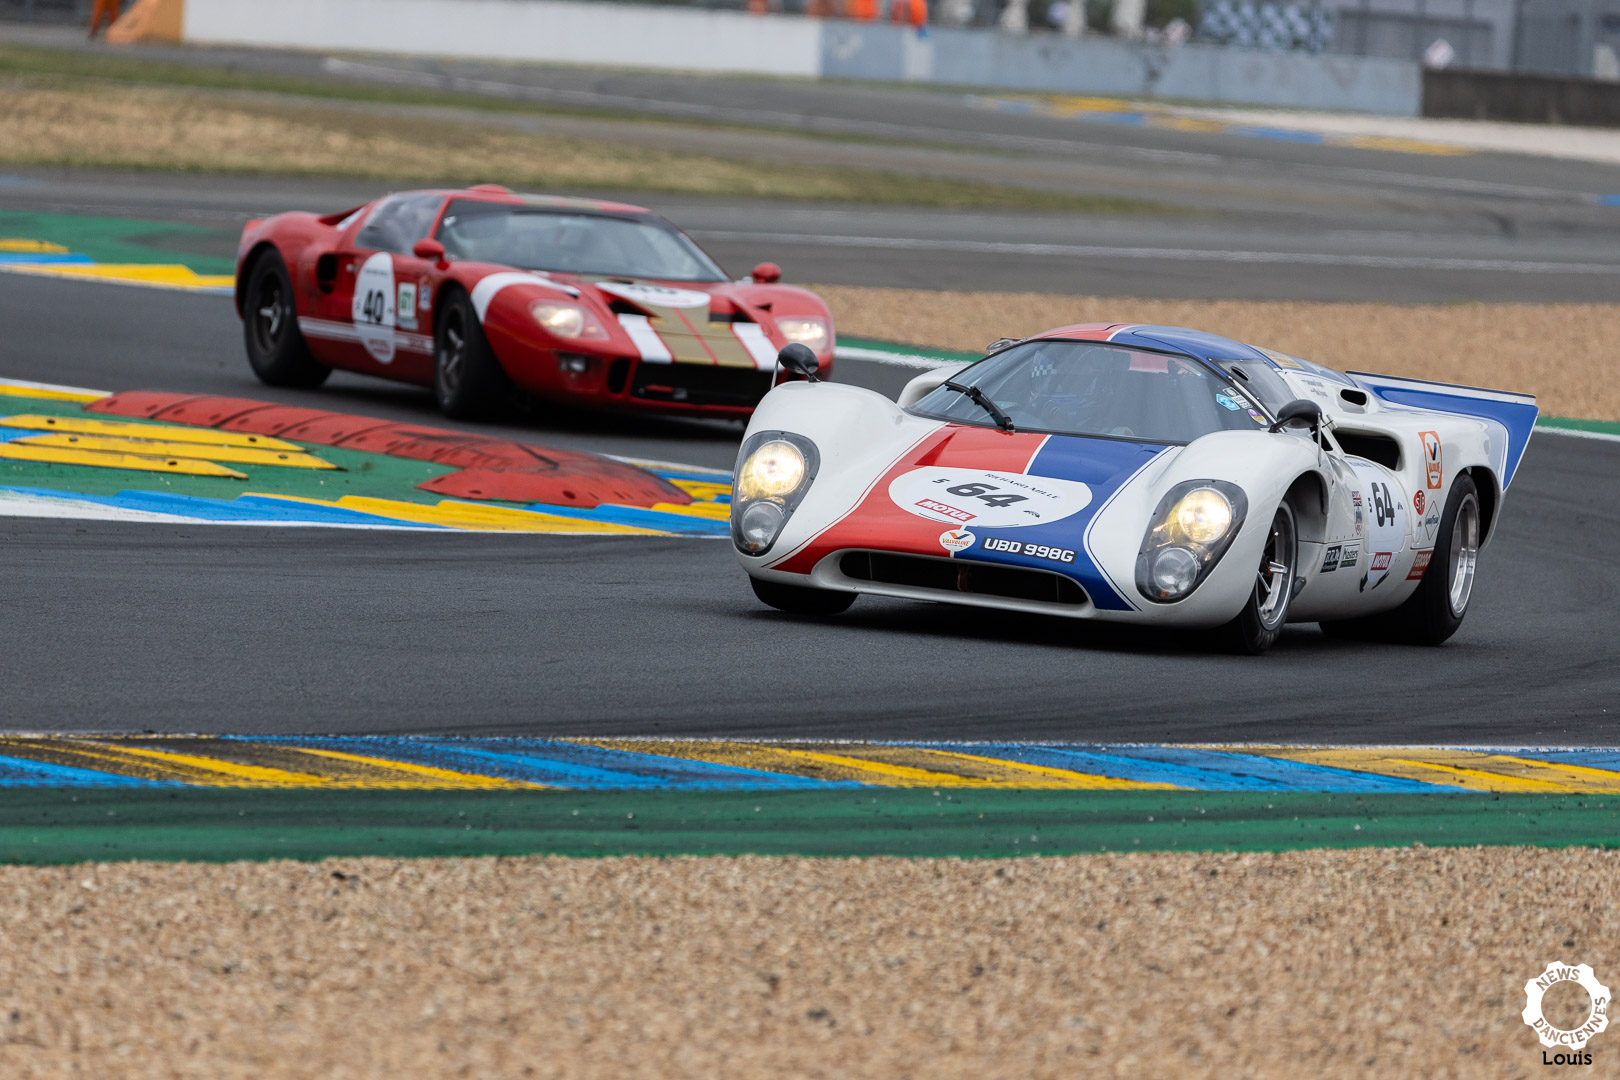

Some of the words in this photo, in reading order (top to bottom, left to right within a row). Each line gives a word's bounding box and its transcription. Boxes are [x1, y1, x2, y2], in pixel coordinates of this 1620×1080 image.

[363, 288, 384, 323] 40
[946, 482, 1030, 508] 64
[1371, 482, 1395, 528] 64
[918, 500, 972, 521] MOTUL
[984, 537, 1021, 553] UBD
[1023, 544, 1075, 563] 998G
